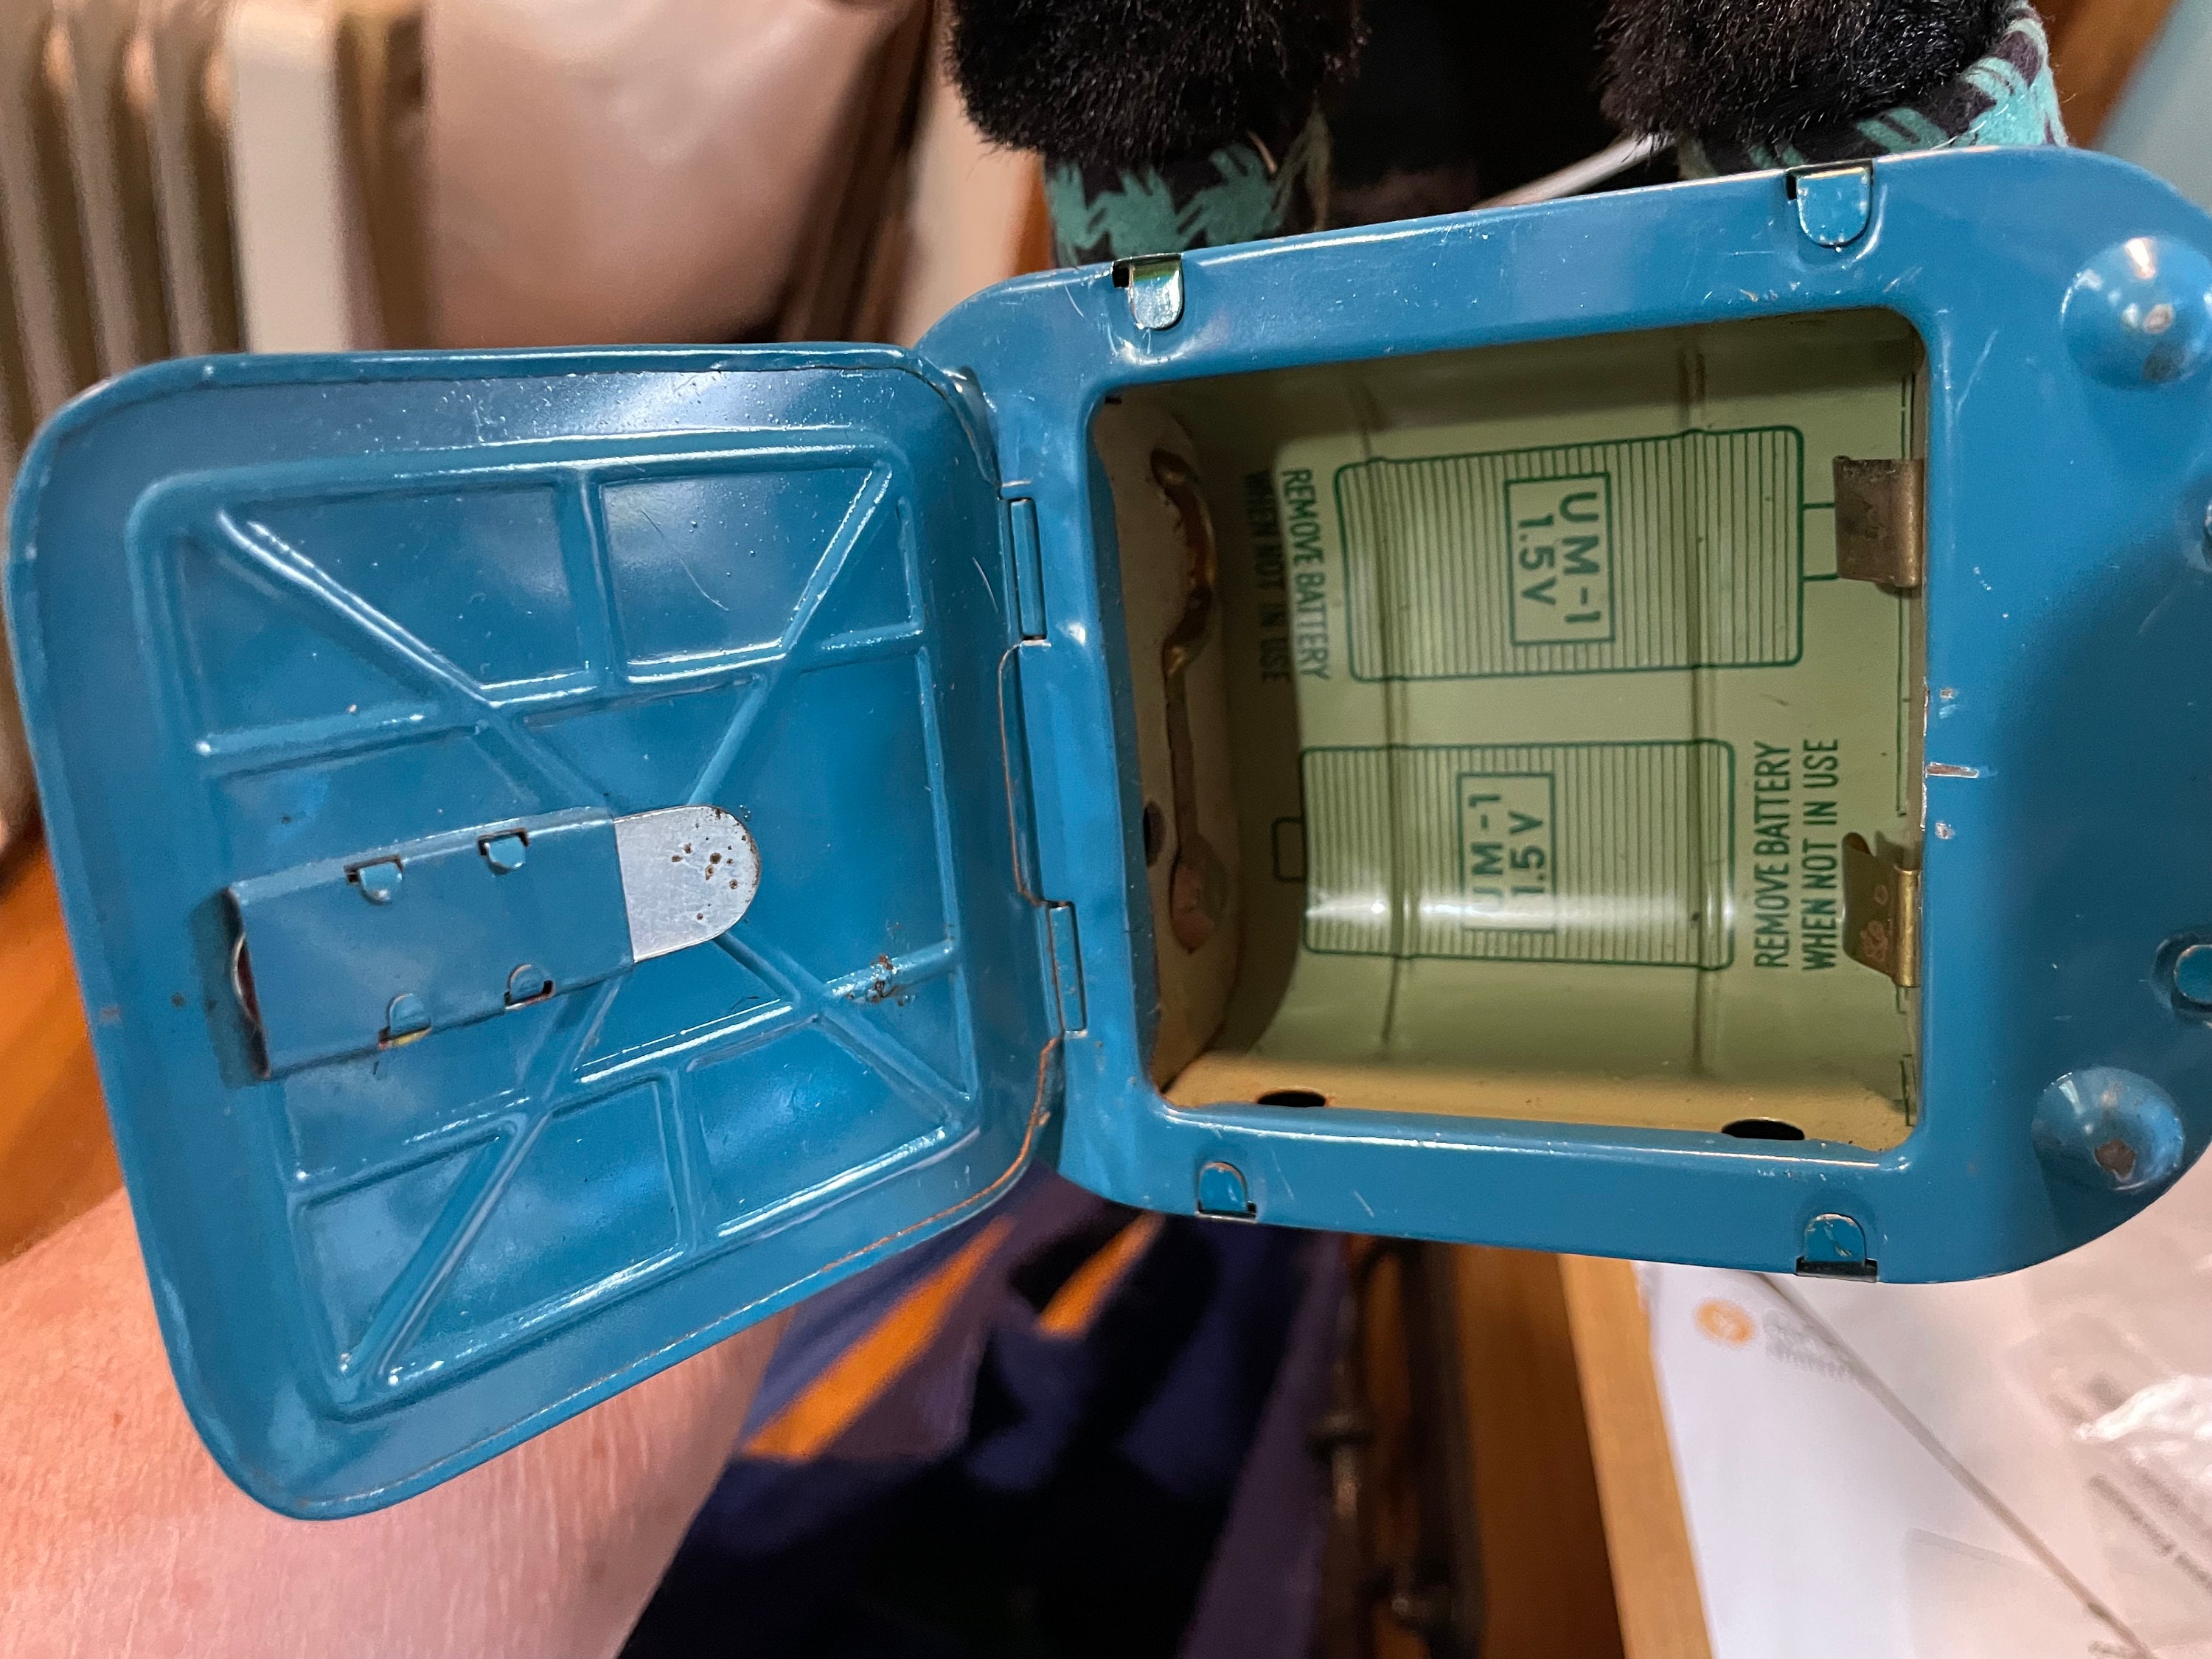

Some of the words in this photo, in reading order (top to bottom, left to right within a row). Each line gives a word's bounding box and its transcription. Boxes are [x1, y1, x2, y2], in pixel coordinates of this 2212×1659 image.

[1281, 469, 1325, 567] REMOVE
[1517, 513, 1558, 606] 1.5V
[1295, 572, 1329, 680] BATTERY
[1753, 741, 1790, 855] BATTERY
[1802, 739, 1838, 788] USE
[1803, 801, 1837, 826] IN
[1802, 838, 1837, 889] NOT
[1753, 863, 1790, 967] REMOVE
[1801, 898, 1837, 970] WHEN
